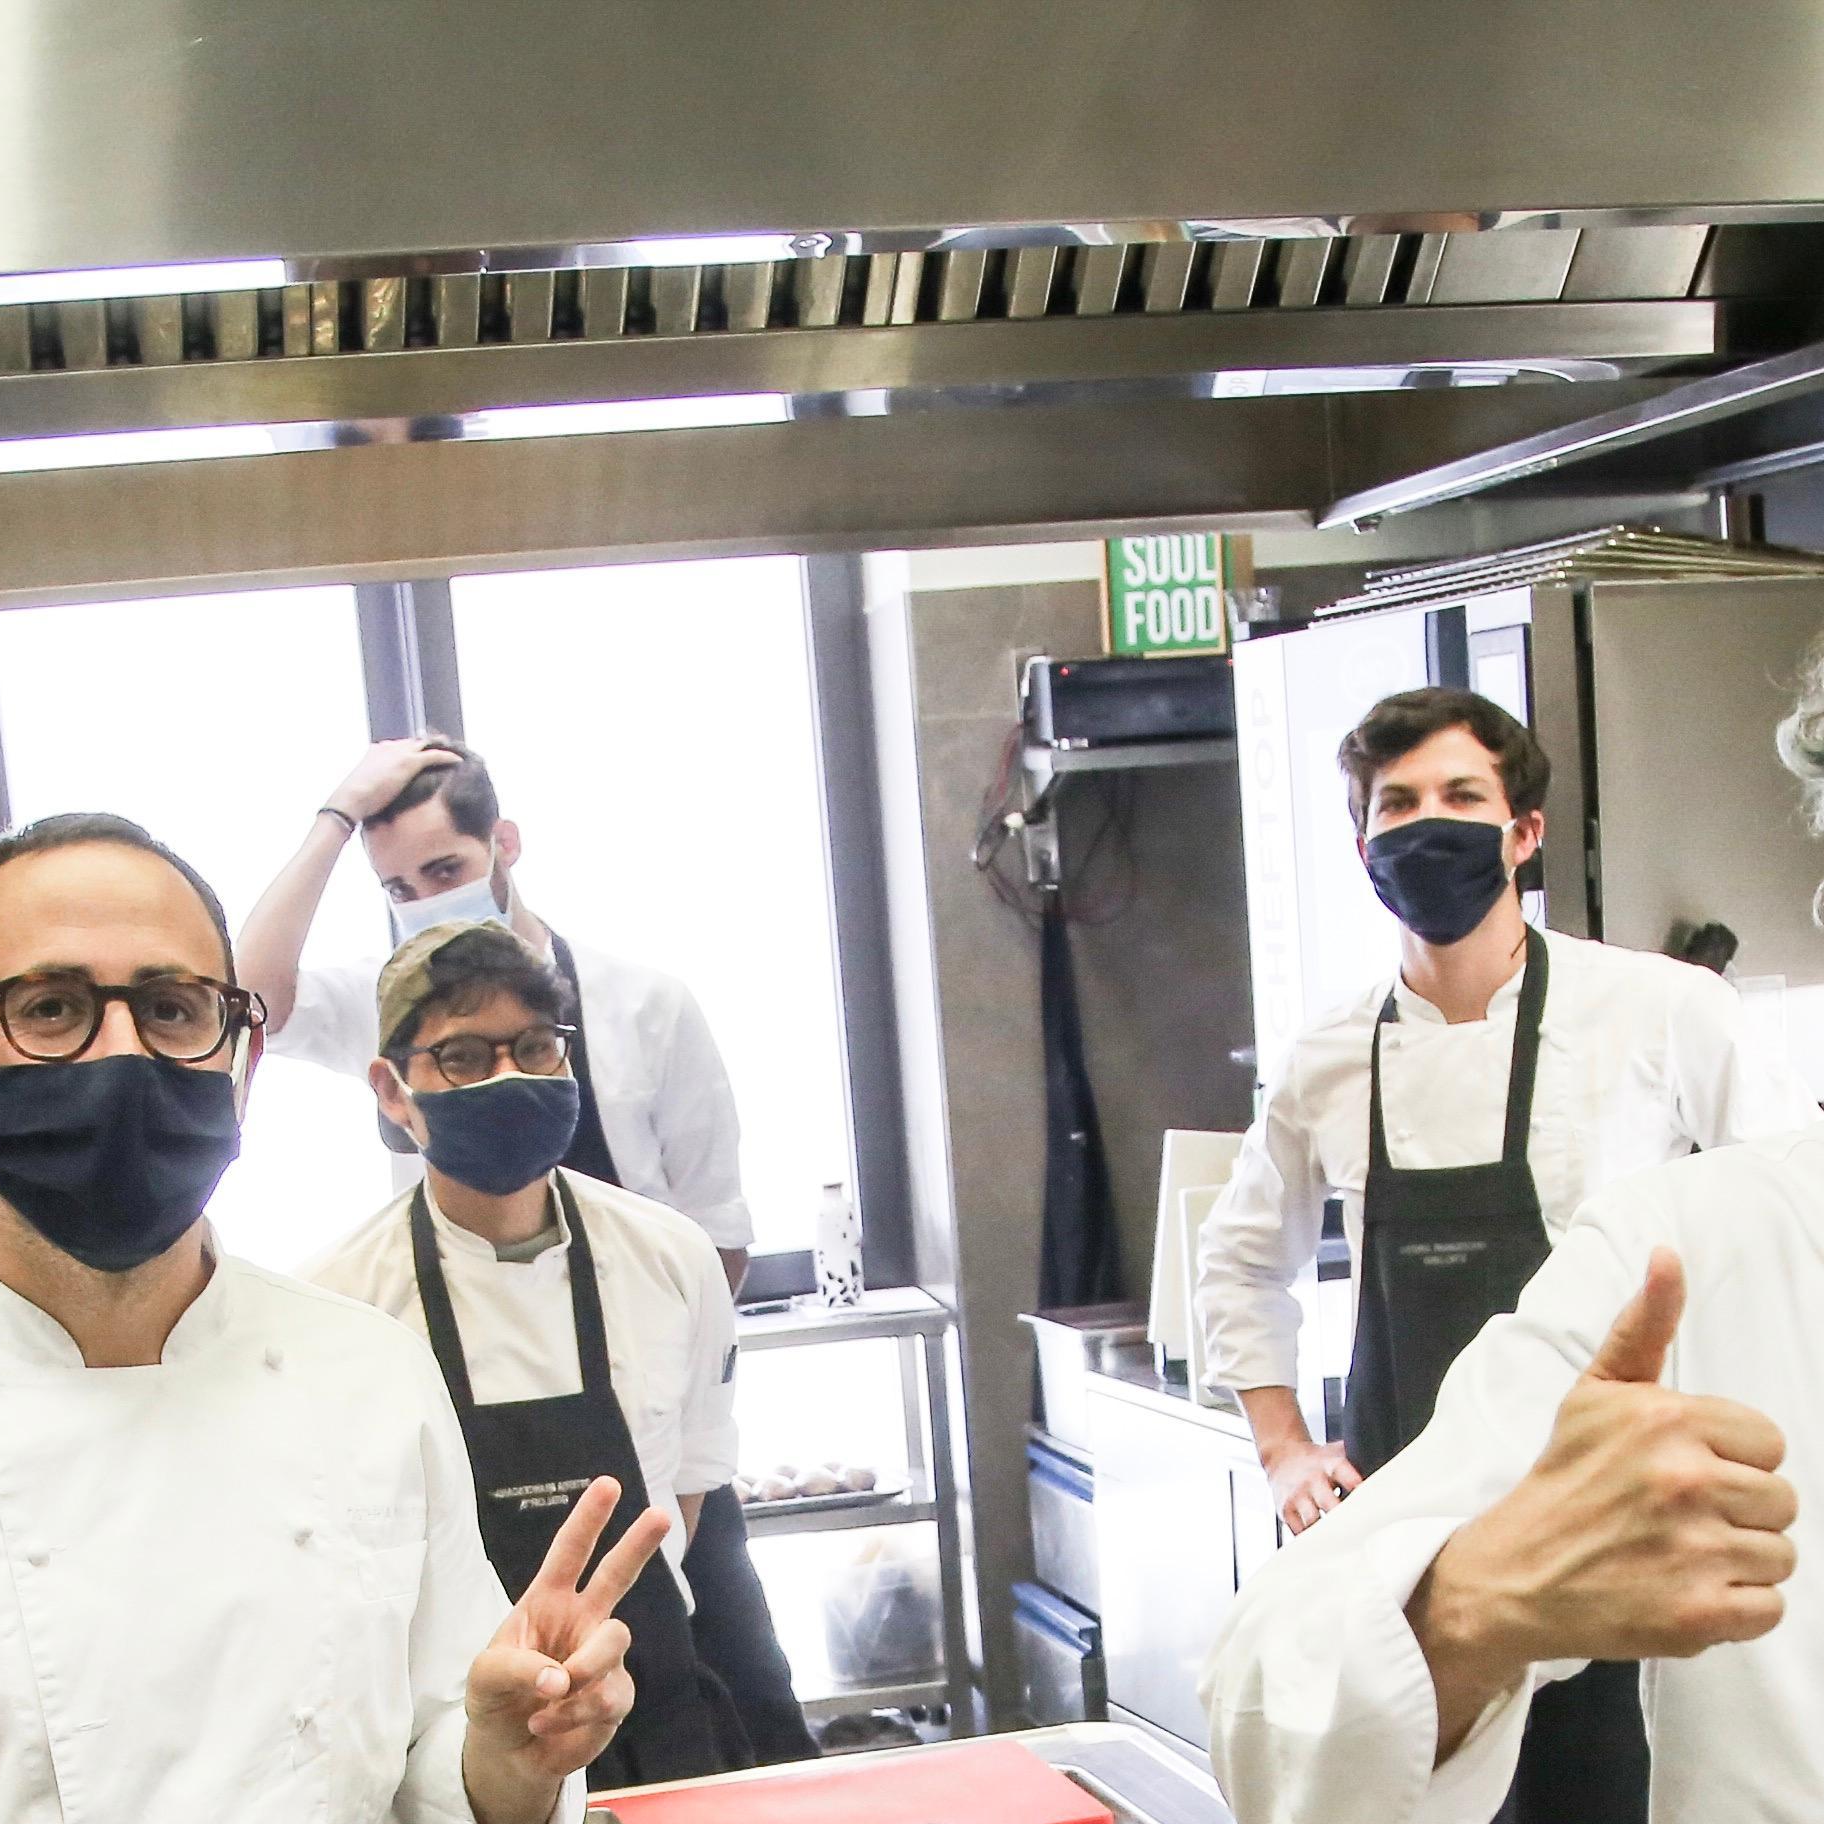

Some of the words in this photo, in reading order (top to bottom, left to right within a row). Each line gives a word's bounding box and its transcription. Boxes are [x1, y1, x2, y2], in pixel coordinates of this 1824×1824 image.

[1122, 532, 1218, 587] SOUL
[1124, 586, 1220, 645] FOOD
[1249, 687, 1294, 1039] CHEFTOP
